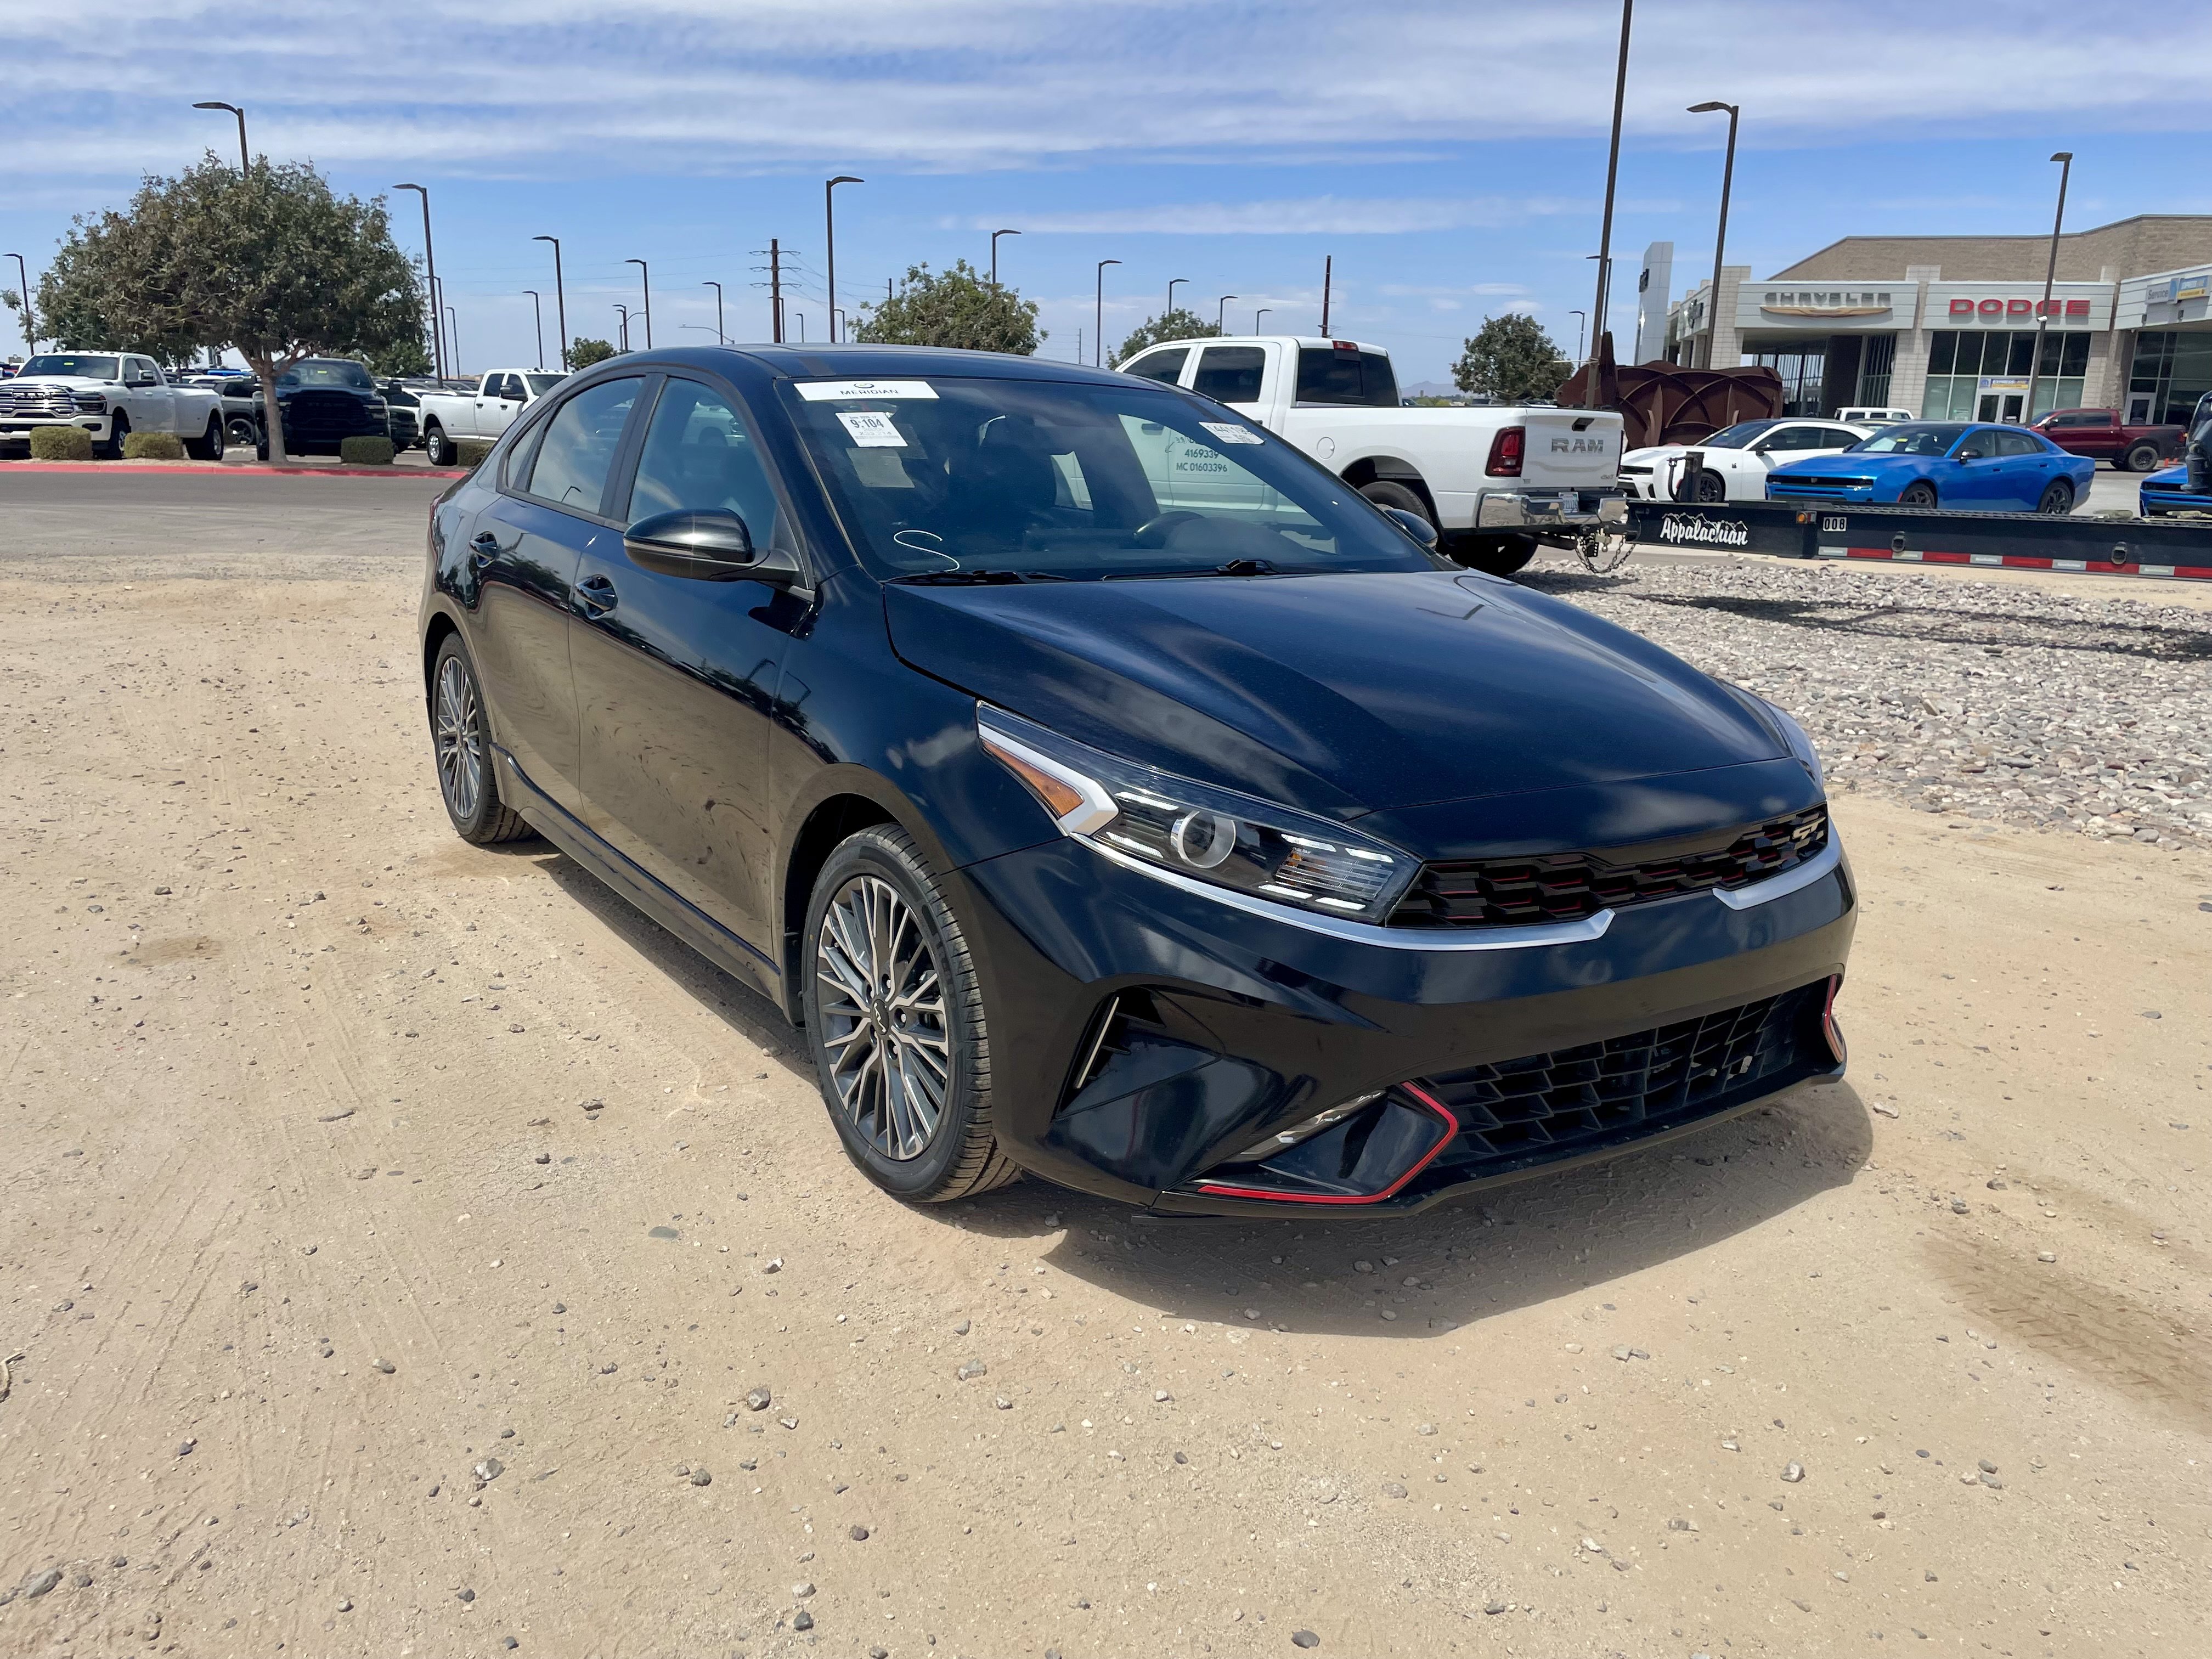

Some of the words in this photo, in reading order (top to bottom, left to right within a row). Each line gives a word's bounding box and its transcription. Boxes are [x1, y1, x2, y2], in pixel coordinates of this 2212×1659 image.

[1764, 292, 1891, 307] CHRYSLER
[1949, 299, 2091, 316] DODGE
[849, 419, 884, 428] 9:104
[1551, 438, 1604, 454] RAM
[1184, 449, 1219, 459] 4169339
[1176, 462, 1188, 471] MC
[1189, 463, 1228, 472] 01603396
[1660, 517, 1748, 545] Appalachian
[1824, 518, 1845, 529] 008
[1792, 816, 1826, 840] GT
